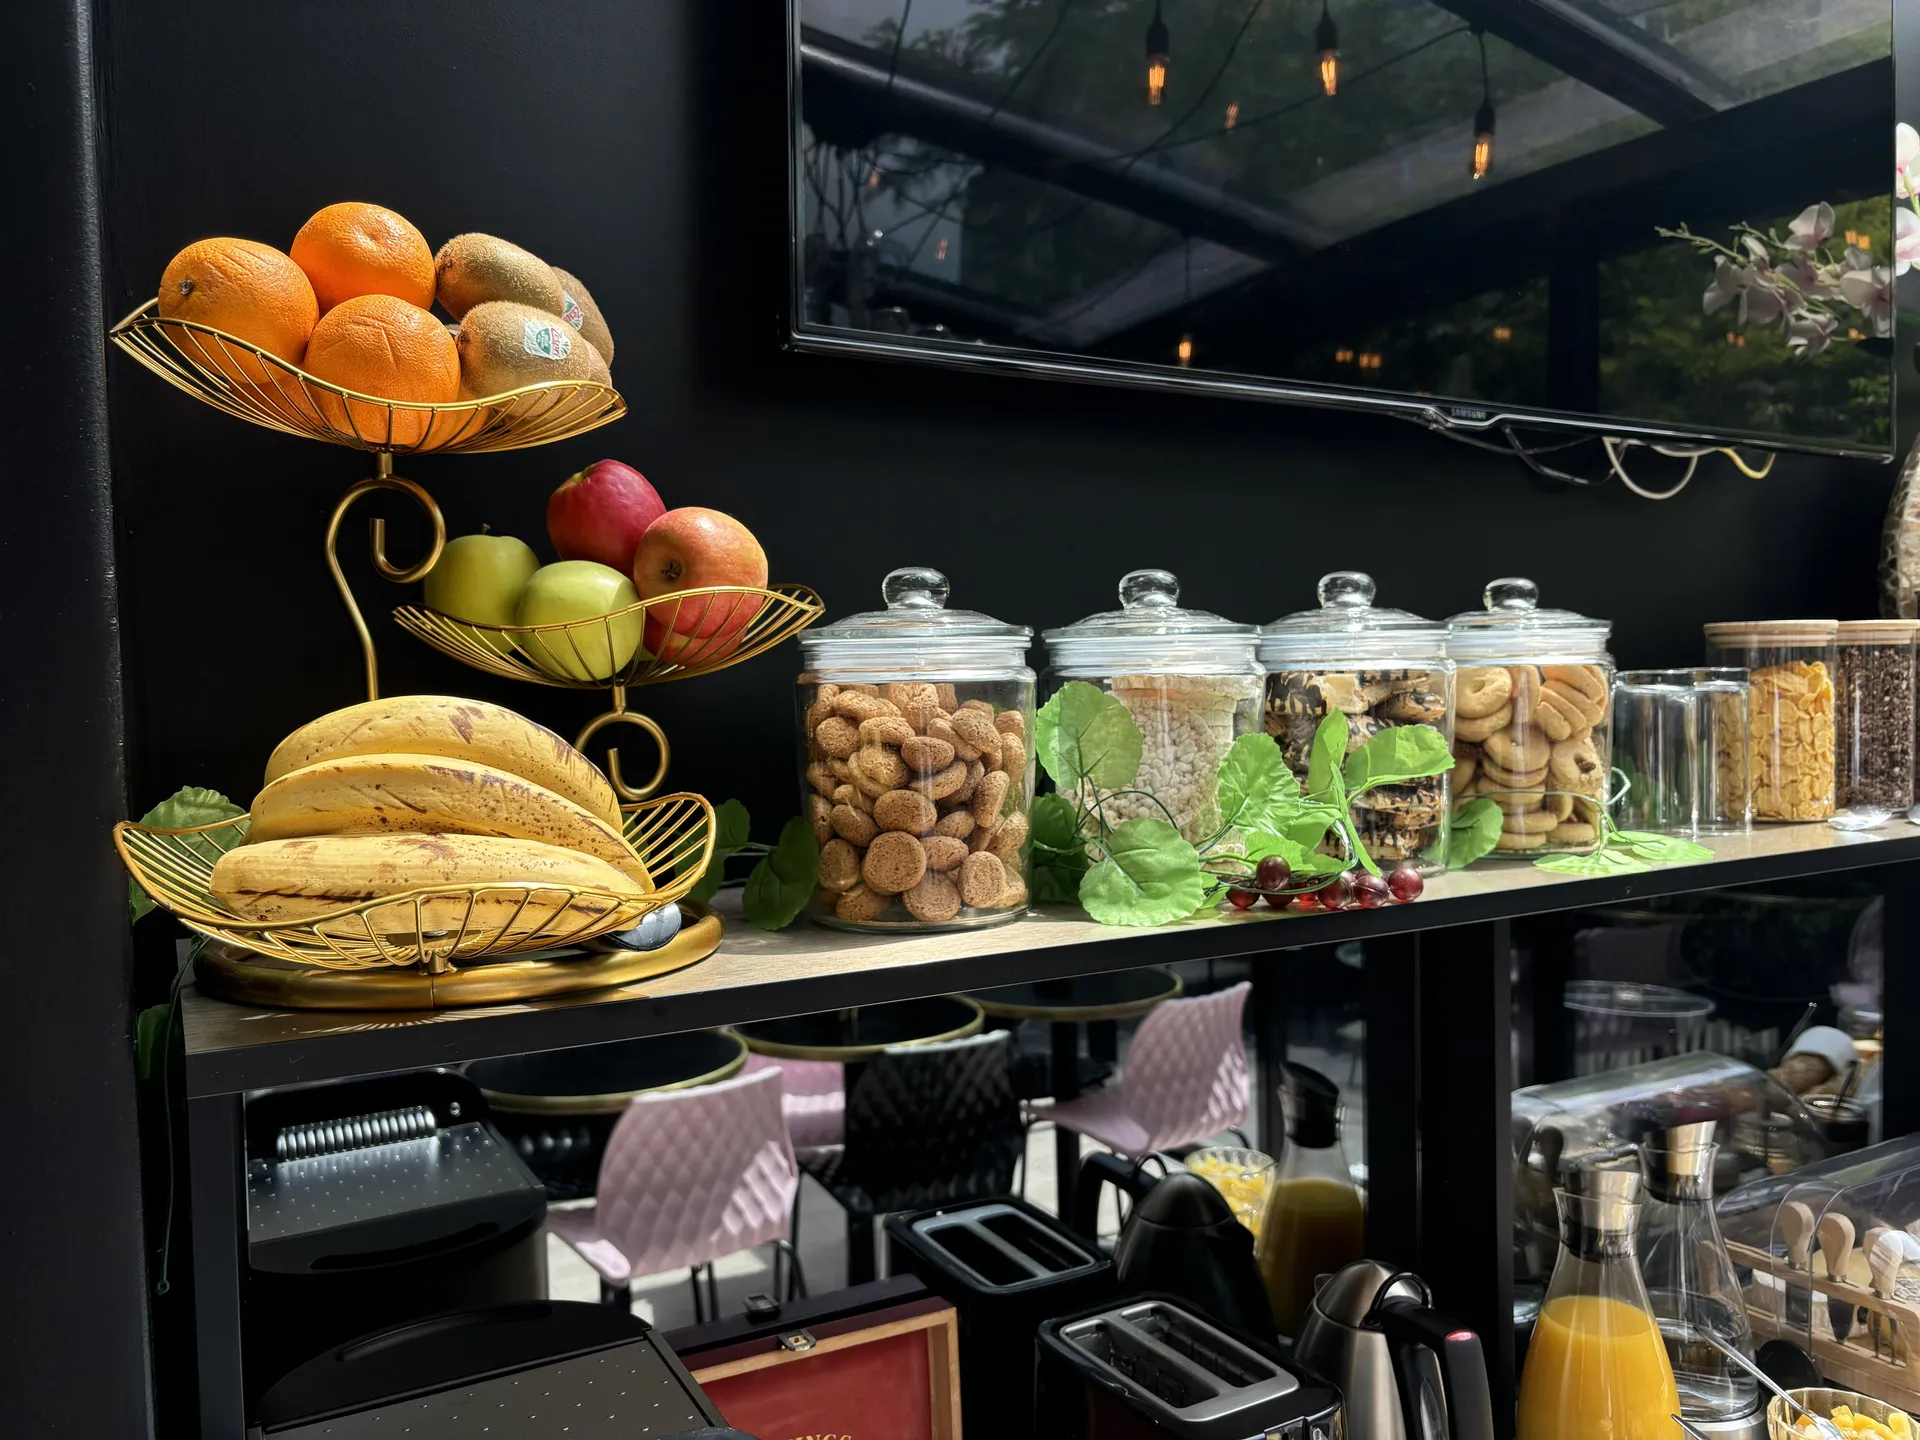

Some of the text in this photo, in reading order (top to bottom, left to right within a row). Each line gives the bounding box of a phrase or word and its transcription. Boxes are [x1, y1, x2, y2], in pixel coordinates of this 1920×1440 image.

[563, 306, 583, 323] Zesp
[551, 328, 562, 357] Zespri
[1451, 407, 1487, 420] SAMSUNG
